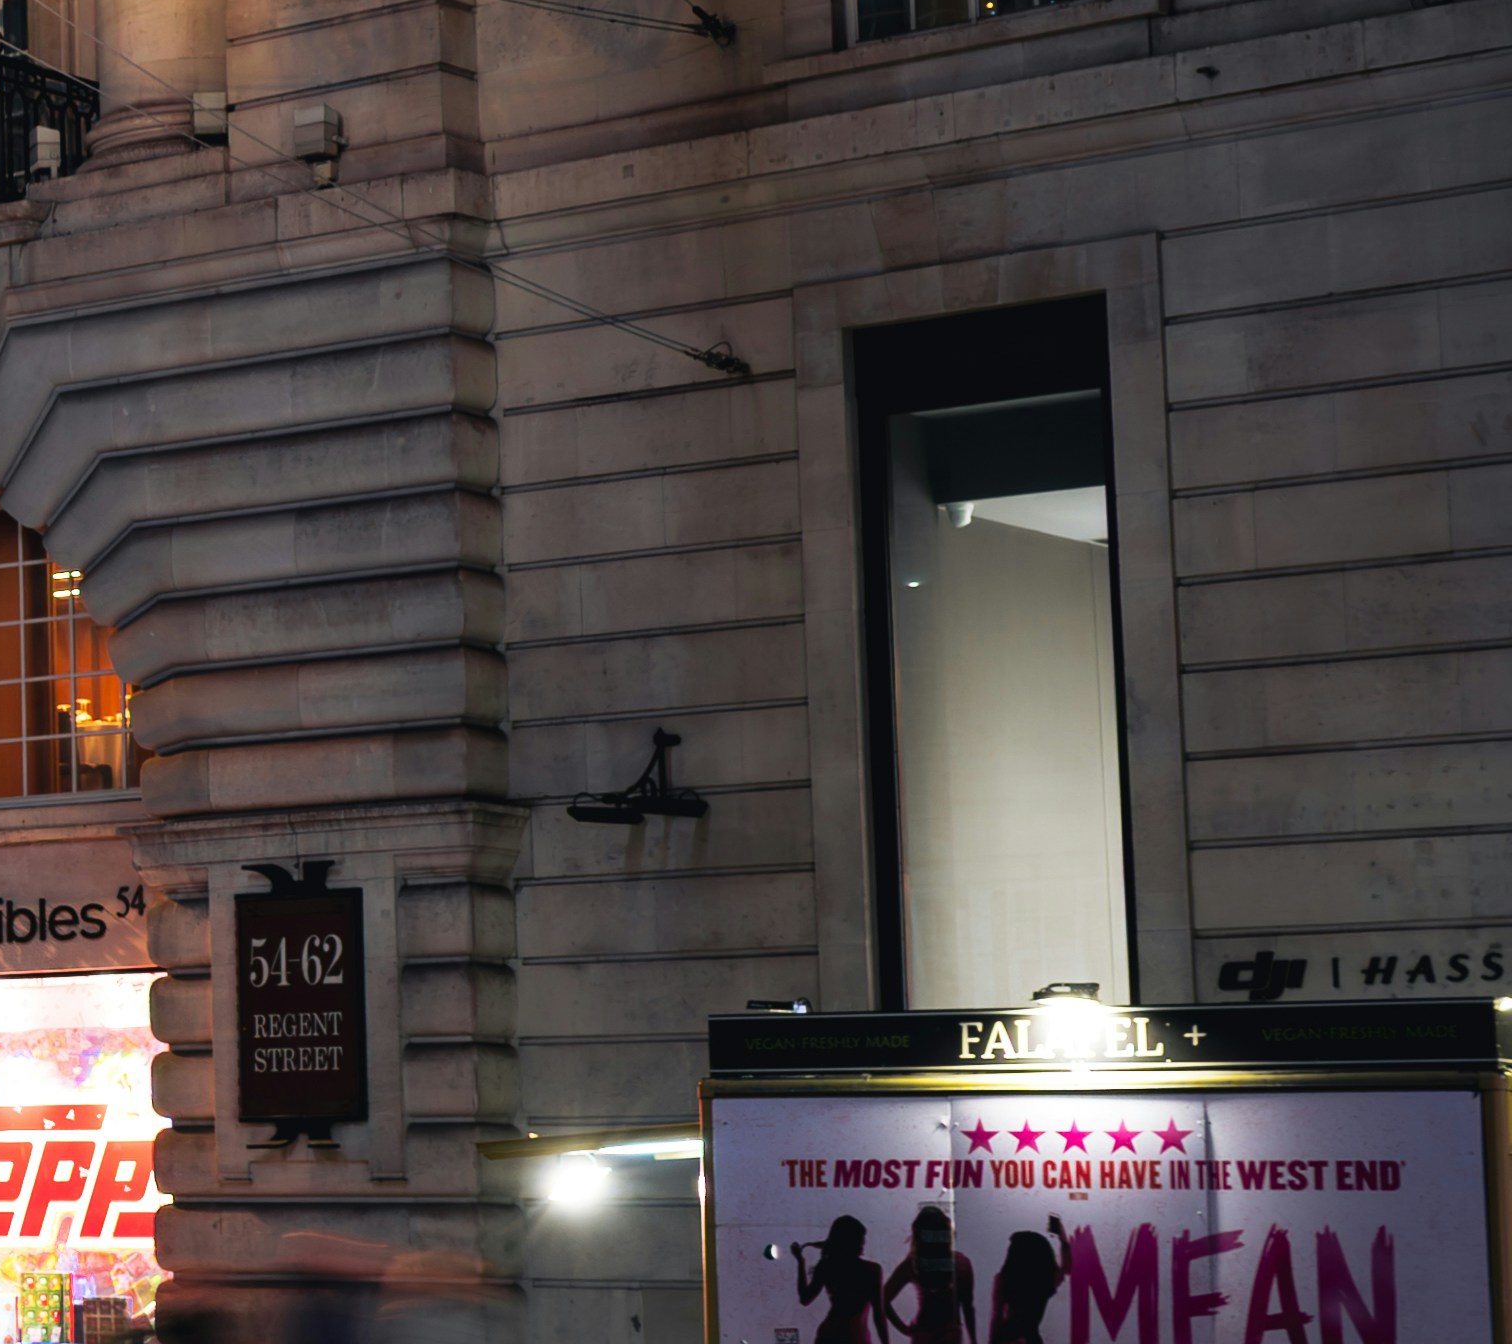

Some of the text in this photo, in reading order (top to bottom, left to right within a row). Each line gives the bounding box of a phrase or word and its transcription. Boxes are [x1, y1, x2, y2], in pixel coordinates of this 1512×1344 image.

[115, 885, 146, 918] 54
[249, 934, 343, 988] 54-62
[253, 1011, 343, 1038] REGENT
[959, 1017, 1164, 1059] FALEL
[866, 1034, 911, 1049] MADE
[254, 1046, 344, 1073] STREET
[833, 1159, 920, 1189] MOST
[925, 1160, 984, 1189] FUN
[990, 1160, 1035, 1189] YOU
[1043, 1160, 1092, 1189] CAN
[1099, 1160, 1162, 1190] HAVE
[1169, 1160, 1191, 1190] IN
[1195, 1160, 1232, 1190] THE
[1237, 1160, 1328, 1191] WEST
